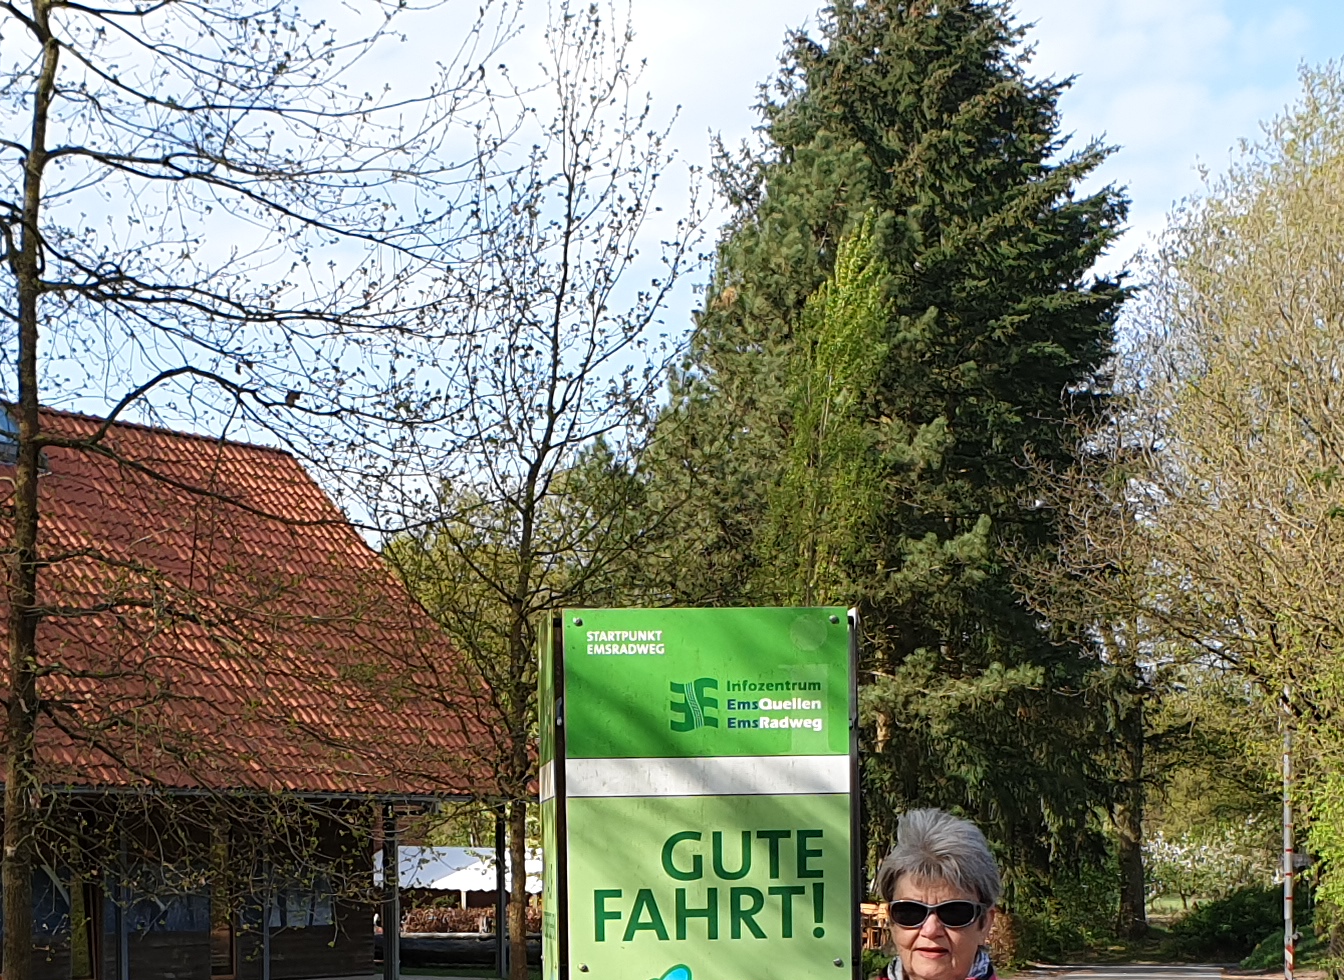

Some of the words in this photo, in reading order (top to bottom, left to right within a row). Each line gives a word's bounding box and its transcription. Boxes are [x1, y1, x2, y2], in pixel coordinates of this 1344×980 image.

[586, 630, 662, 642] STARTPUNKT
[586, 643, 665, 655] EMSRADWEG
[727, 679, 822, 693] Infozentrum
[727, 697, 822, 712] EmsQuellen
[727, 717, 823, 732] EmsRadweg
[661, 829, 824, 881] GUTE
[593, 882, 825, 942] FAHRT!
